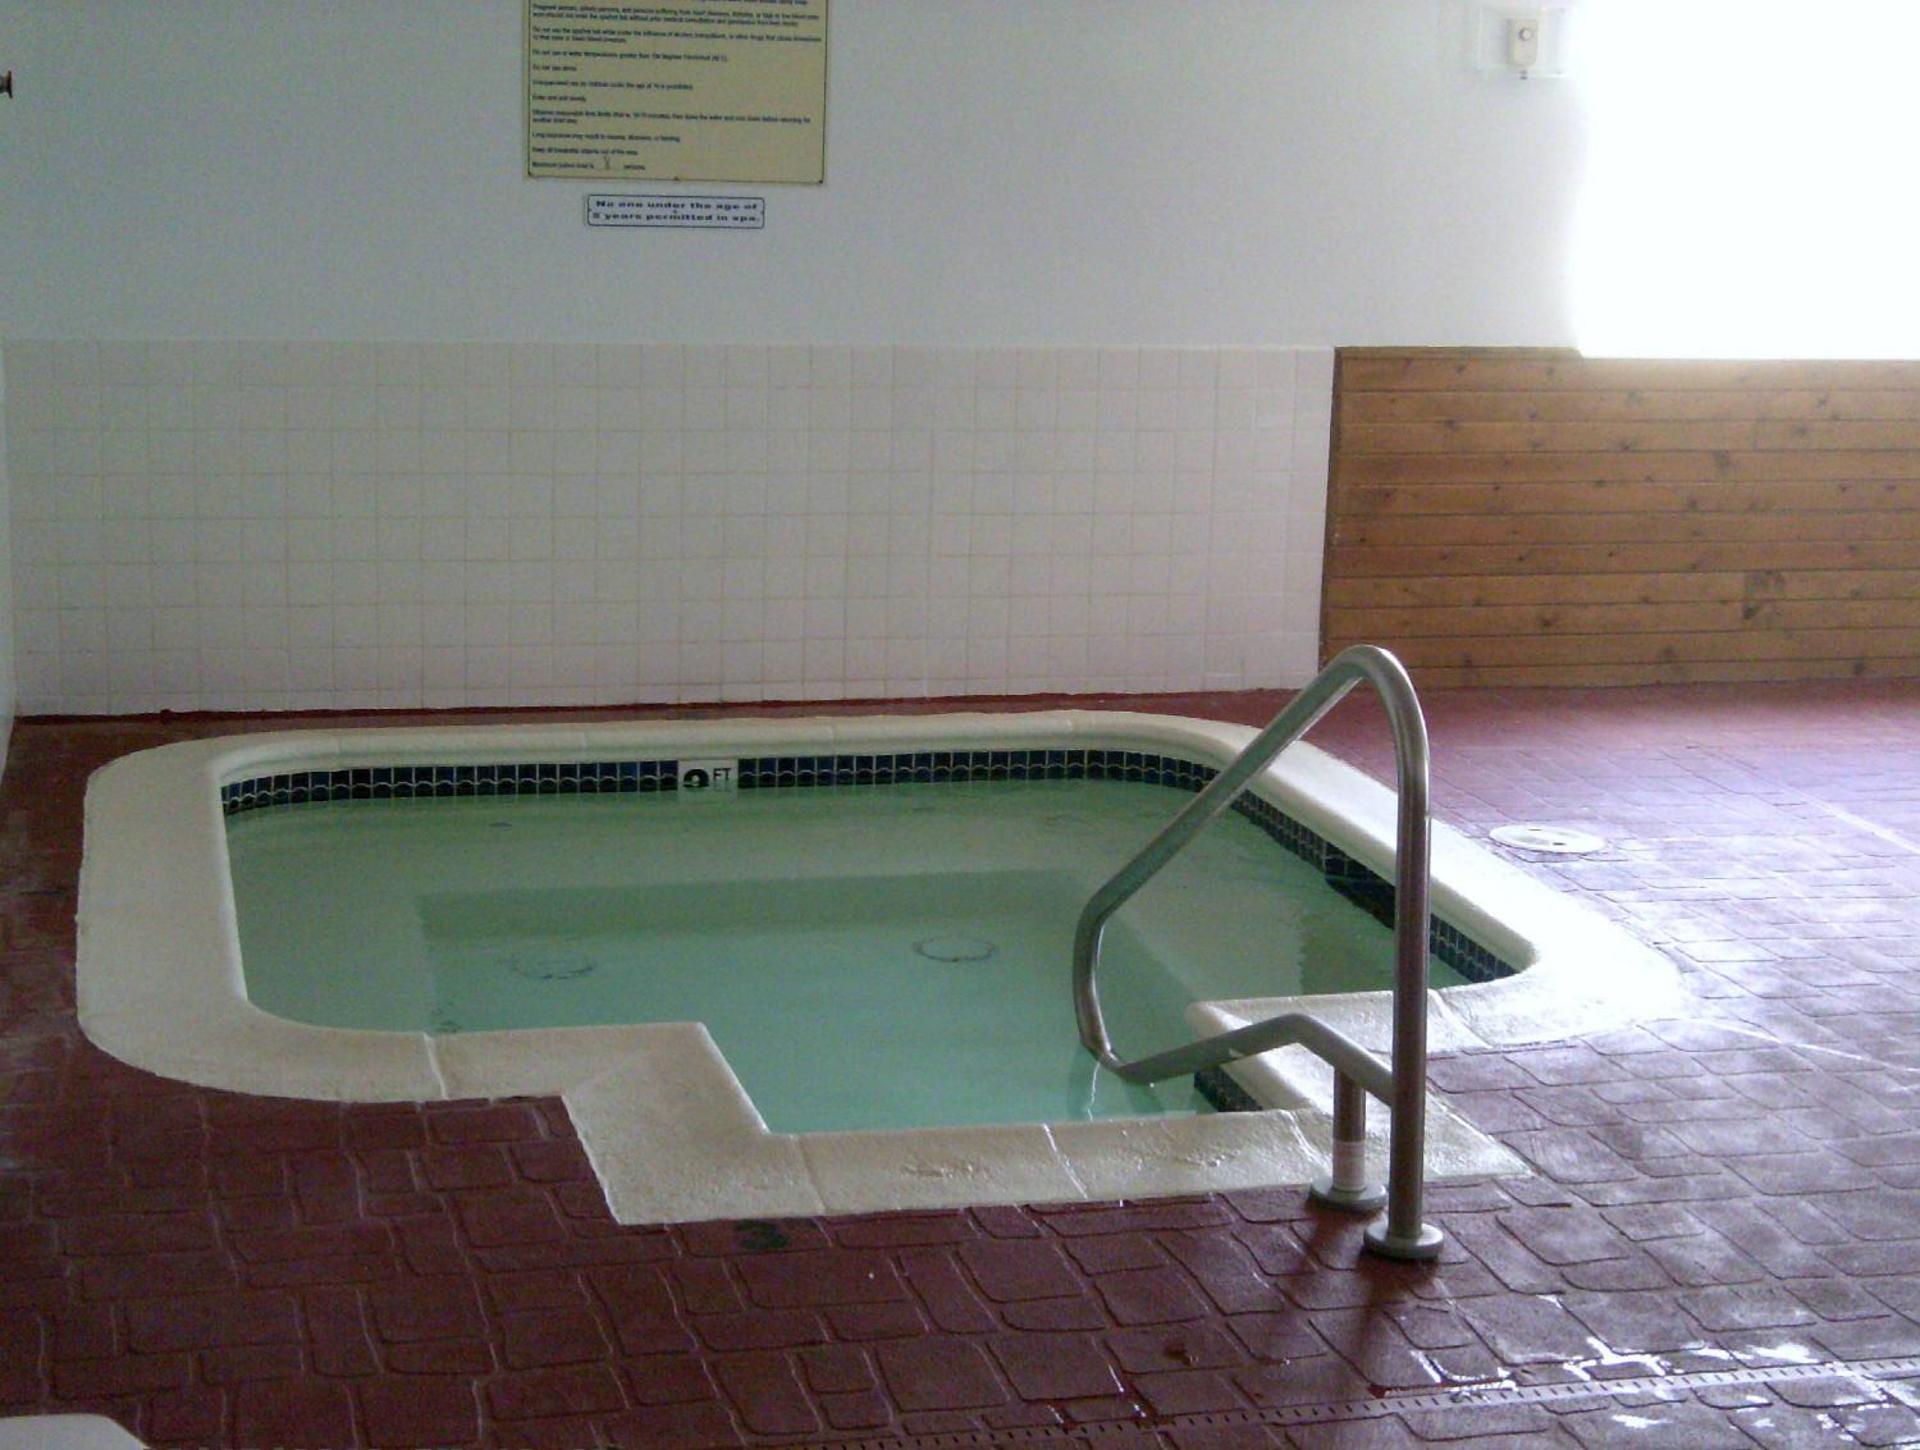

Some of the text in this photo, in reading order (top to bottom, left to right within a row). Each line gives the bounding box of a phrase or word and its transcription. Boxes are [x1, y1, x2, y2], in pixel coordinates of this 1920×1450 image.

[596, 200, 757, 212] No one under the age of
[604, 213, 642, 221] years
[645, 212, 713, 222] permitted
[716, 214, 728, 222] in
[713, 767, 732, 782] FT
